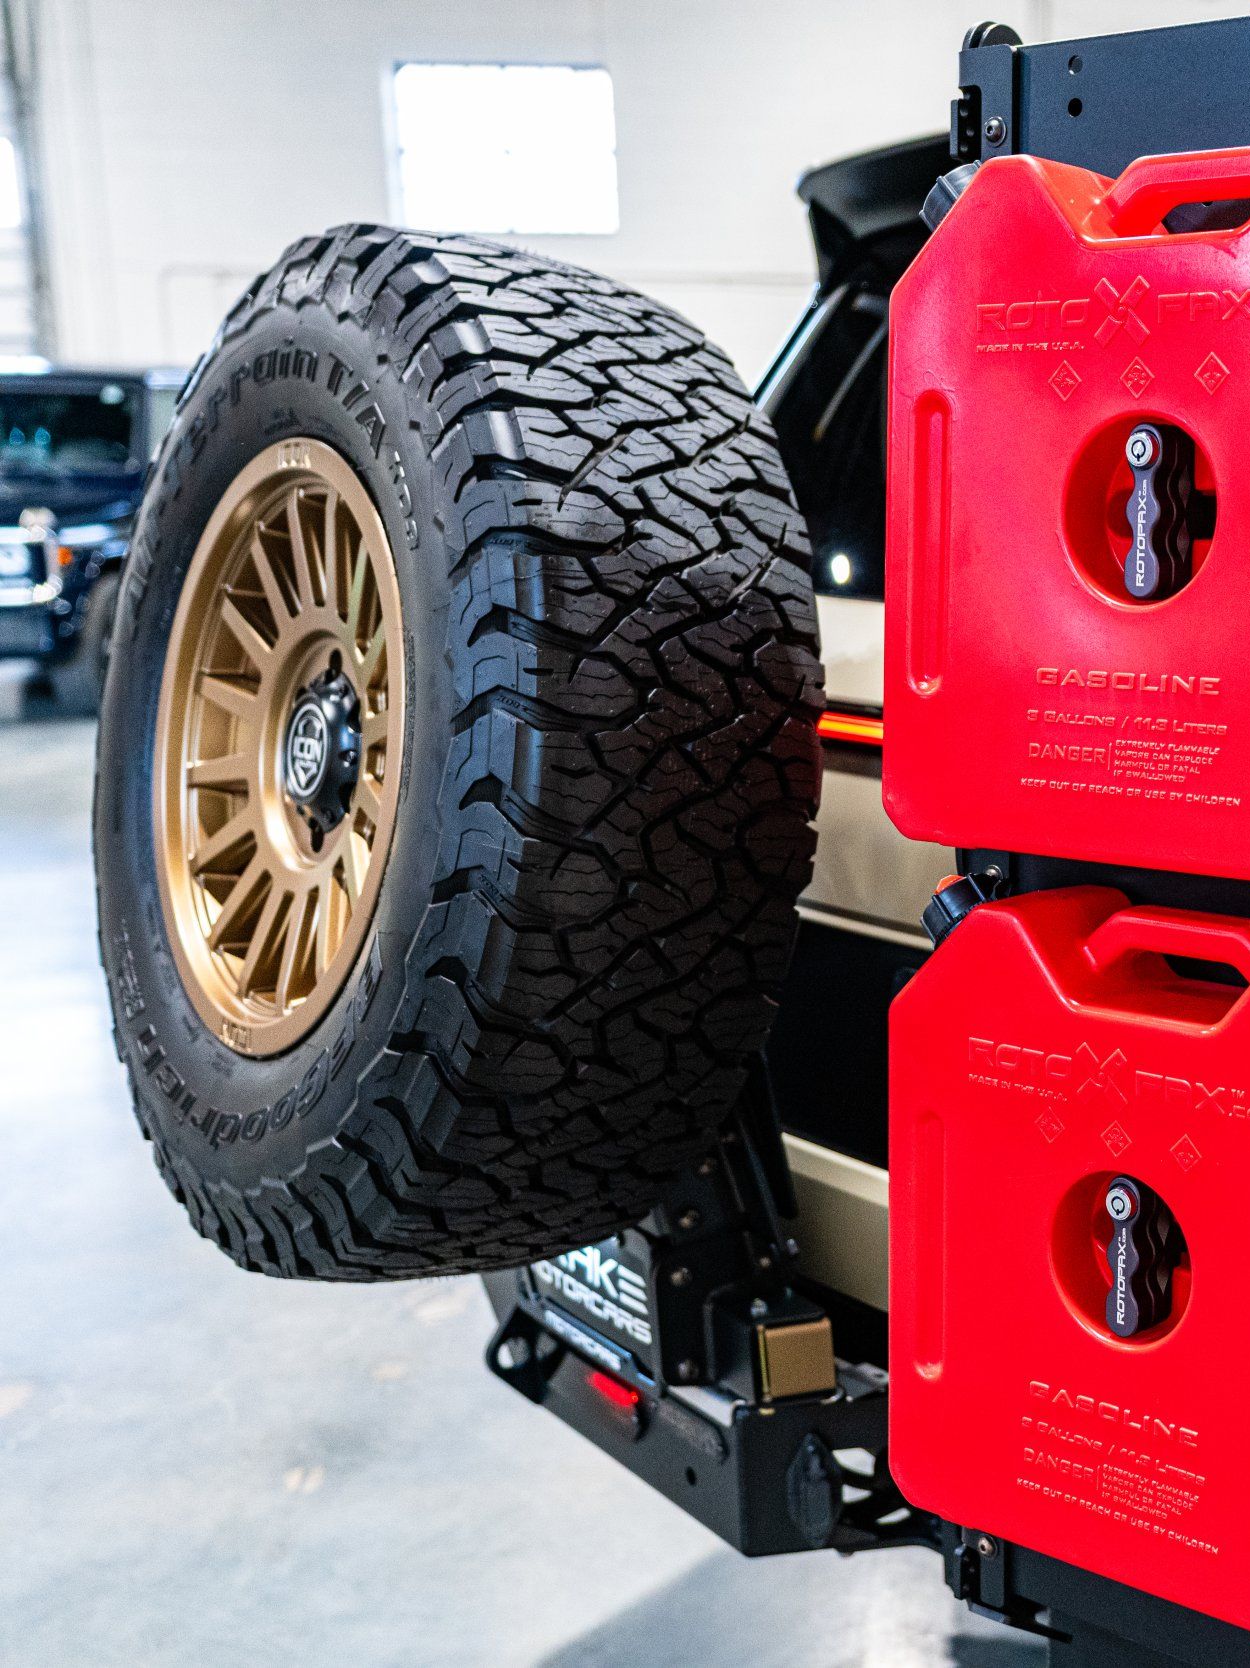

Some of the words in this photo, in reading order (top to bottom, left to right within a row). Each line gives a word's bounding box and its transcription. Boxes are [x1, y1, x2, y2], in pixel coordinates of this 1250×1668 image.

[976, 343, 1009, 354] MADE
[1010, 343, 1024, 353] IN
[1026, 341, 1048, 352] THE
[1135, 498, 1147, 587] ROTOPAX
[1036, 667, 1221, 695] GASOLINE
[1026, 709, 1039, 722] 3
[1043, 710, 1115, 728] GALLONS
[1133, 717, 1168, 732] 11.3
[1172, 719, 1228, 736] LITERS
[1028, 742, 1107, 764] DANGER
[1114, 739, 1165, 751] EXTREMELY
[1167, 743, 1221, 755] FLAMMABLE
[1114, 749, 1149, 760] VAPORS
[1152, 751, 1171, 762] CAN
[1173, 753, 1213, 765] EXPLODE
[1113, 769, 1122, 778] IF
[1125, 770, 1186, 783] SWALLOWED
[1114, 759, 1155, 771] HARMFUL
[1157, 762, 1171, 772] OR
[1172, 763, 1201, 774] FATAL
[1020, 777, 1047, 788] KEEP
[1049, 781, 1069, 791] OUT
[1072, 782, 1087, 793] OF
[1088, 784, 1123, 795] REACH
[1126, 787, 1141, 797] OR
[1145, 789, 1165, 799] USE
[1169, 791, 1183, 801] BY
[1186, 792, 1241, 807] CHILDREN
[1029, 1380, 1199, 1448] GASOLINE
[1037, 1421, 1103, 1450] GALLONS
[1023, 1447, 1094, 1483] DANGER
[1102, 1463, 1149, 1485] EXTREMELY
[1151, 1479, 1200, 1502] FLAMMABLE
[1102, 1482, 1141, 1502] HARMFUL
[1142, 1494, 1154, 1504] OR
[1156, 1499, 1182, 1516] FATAL
[1113, 1495, 1168, 1520] SWALLOWED
[1137, 1484, 1154, 1496] CAN
[1156, 1491, 1194, 1511] EXPLODE
[1016, 1477, 1041, 1492] KEEP
[1043, 1486, 1063, 1498] OUT
[1064, 1494, 1077, 1505] OF
[1079, 1499, 1112, 1517] REACH
[1113, 1511, 1127, 1523] OR
[1130, 1517, 1151, 1531] USE
[1153, 1525, 1166, 1536] BY
[1168, 1530, 1219, 1555] CHILDREN
